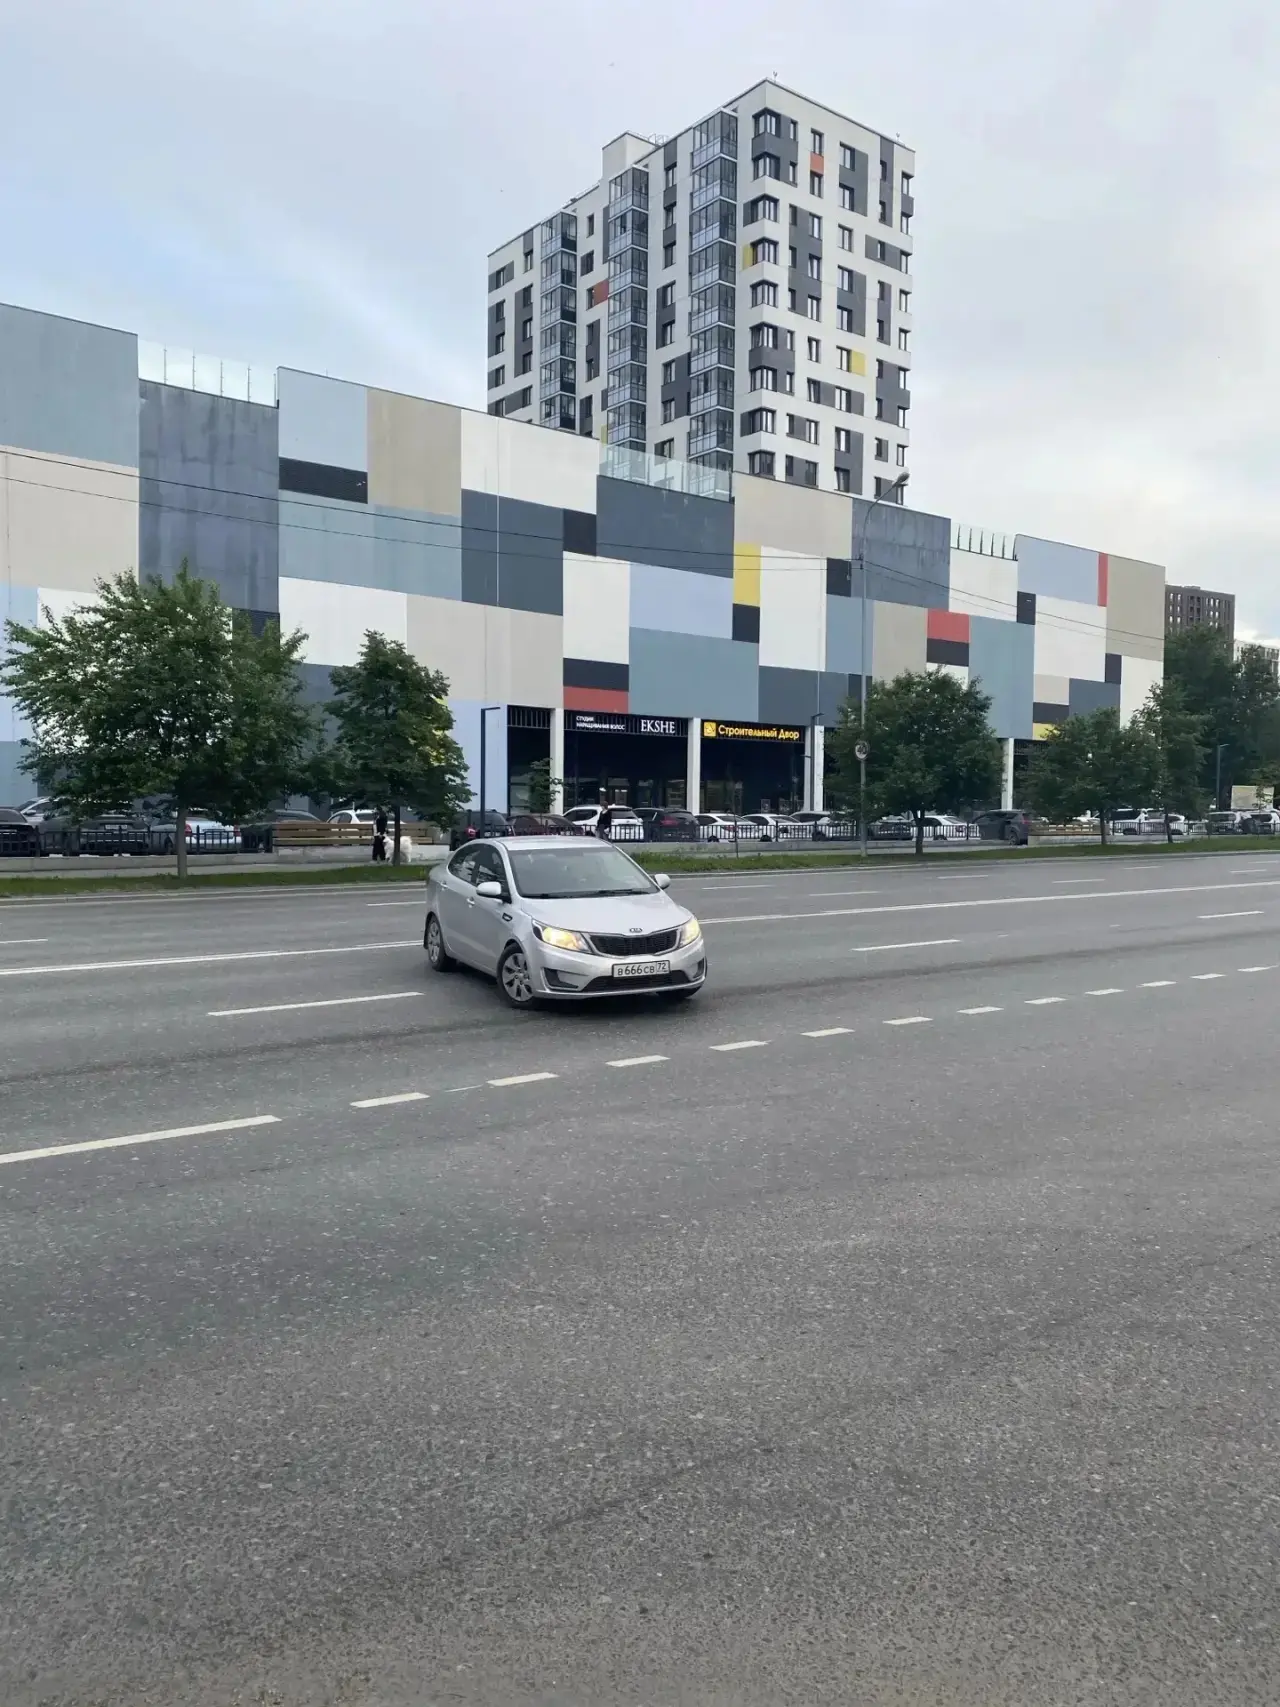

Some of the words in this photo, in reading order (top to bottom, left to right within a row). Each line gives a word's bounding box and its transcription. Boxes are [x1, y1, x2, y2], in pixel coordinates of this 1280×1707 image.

[640, 719, 676, 734] EKSHE
[718, 724, 777, 738] Строительный
[778, 728, 800, 740] Двор
[657, 962, 667, 970] 72
